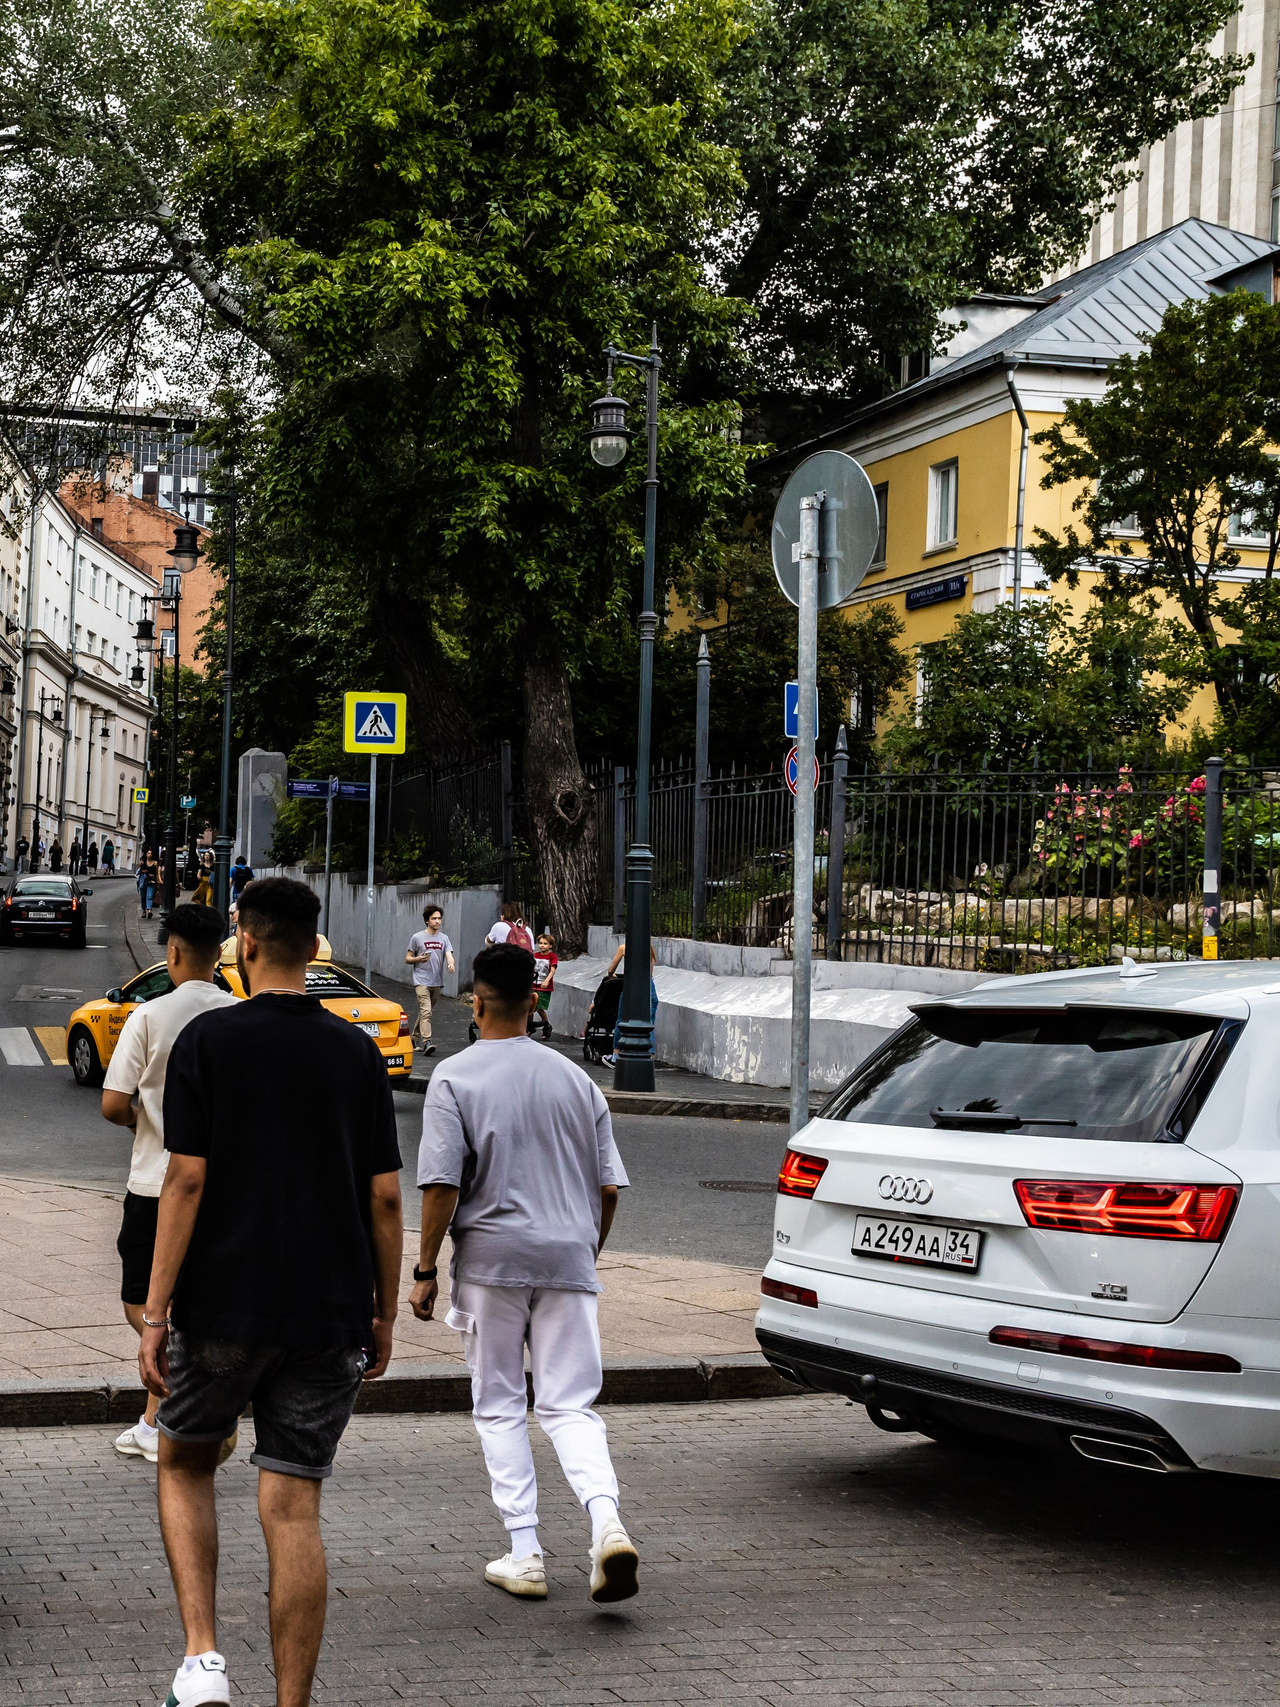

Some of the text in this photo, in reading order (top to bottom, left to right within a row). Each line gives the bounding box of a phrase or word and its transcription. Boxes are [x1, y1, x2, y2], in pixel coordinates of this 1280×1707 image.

[860, 1222, 970, 1258] А249АА 34
[945, 1252, 961, 1261] RUS
